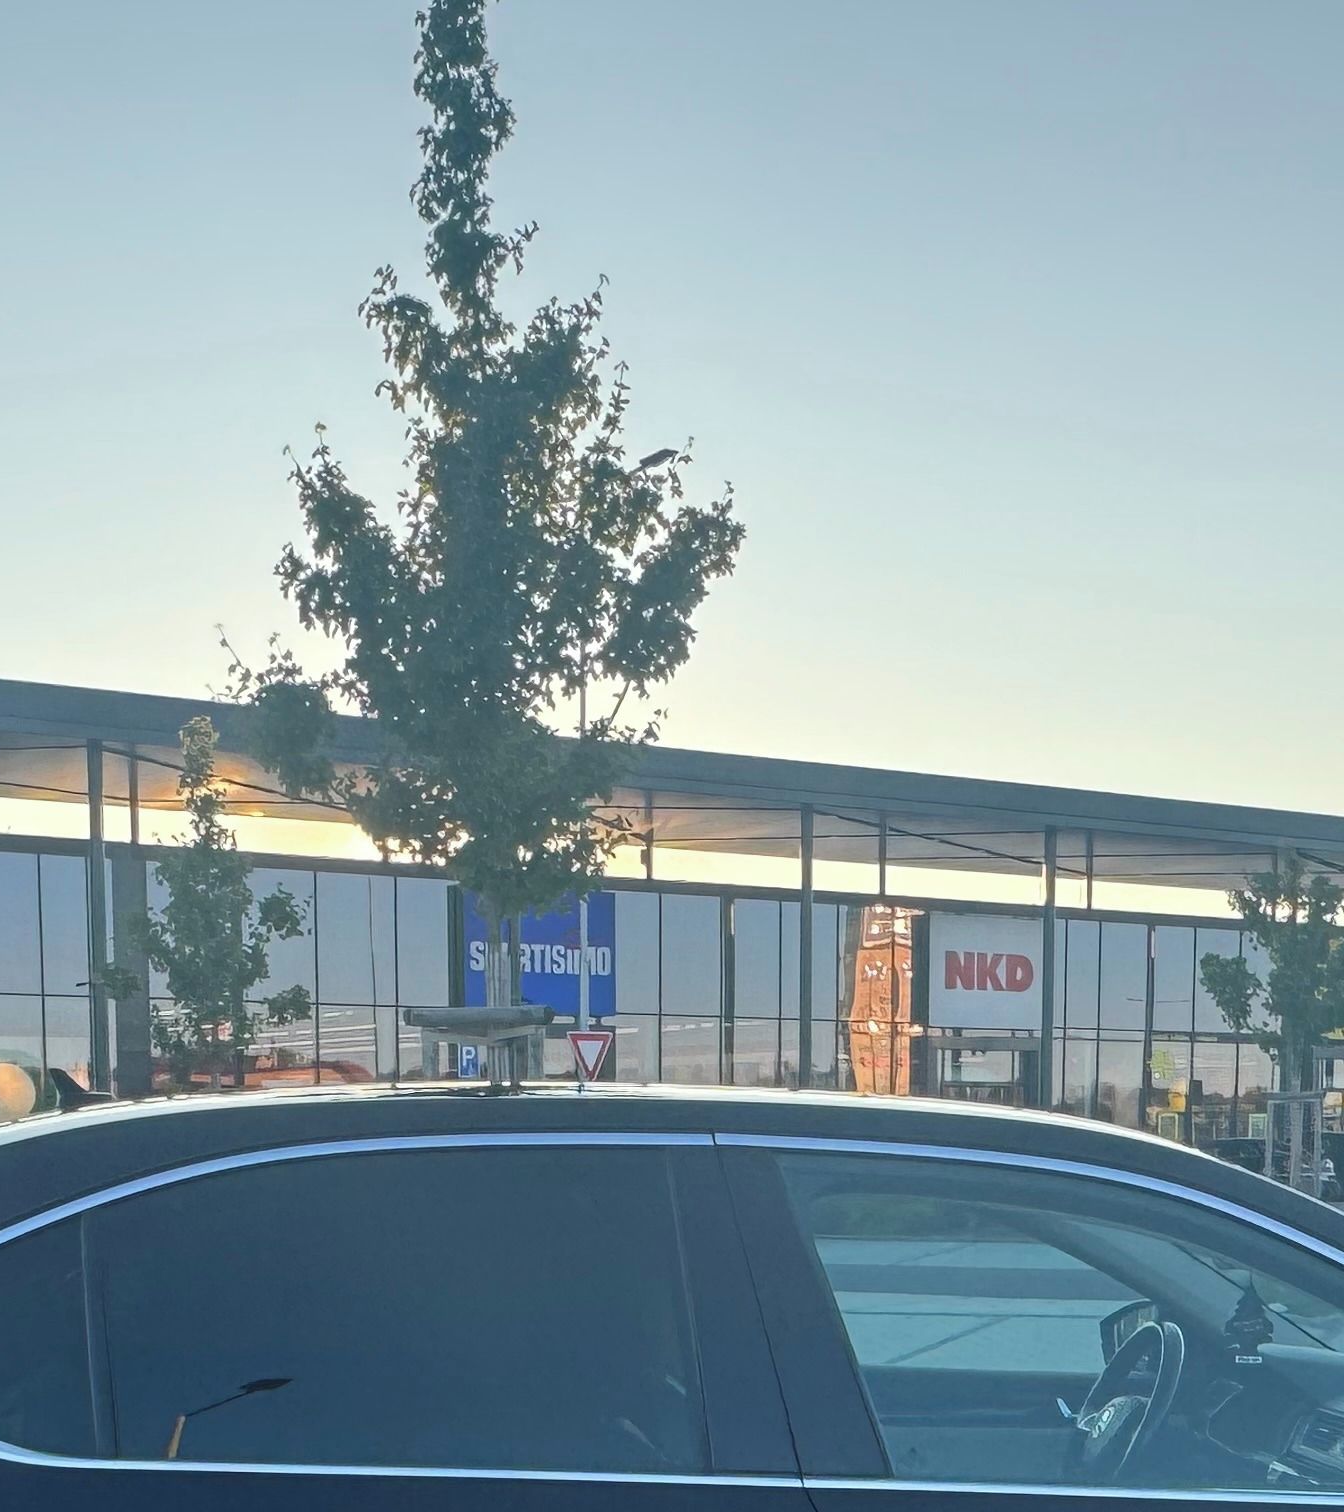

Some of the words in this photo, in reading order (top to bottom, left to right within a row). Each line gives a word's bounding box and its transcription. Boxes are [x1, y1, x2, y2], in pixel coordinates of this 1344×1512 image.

[469, 940, 612, 976] SRTISIMO
[944, 950, 1034, 993] NKD
[462, 1046, 476, 1066] P
